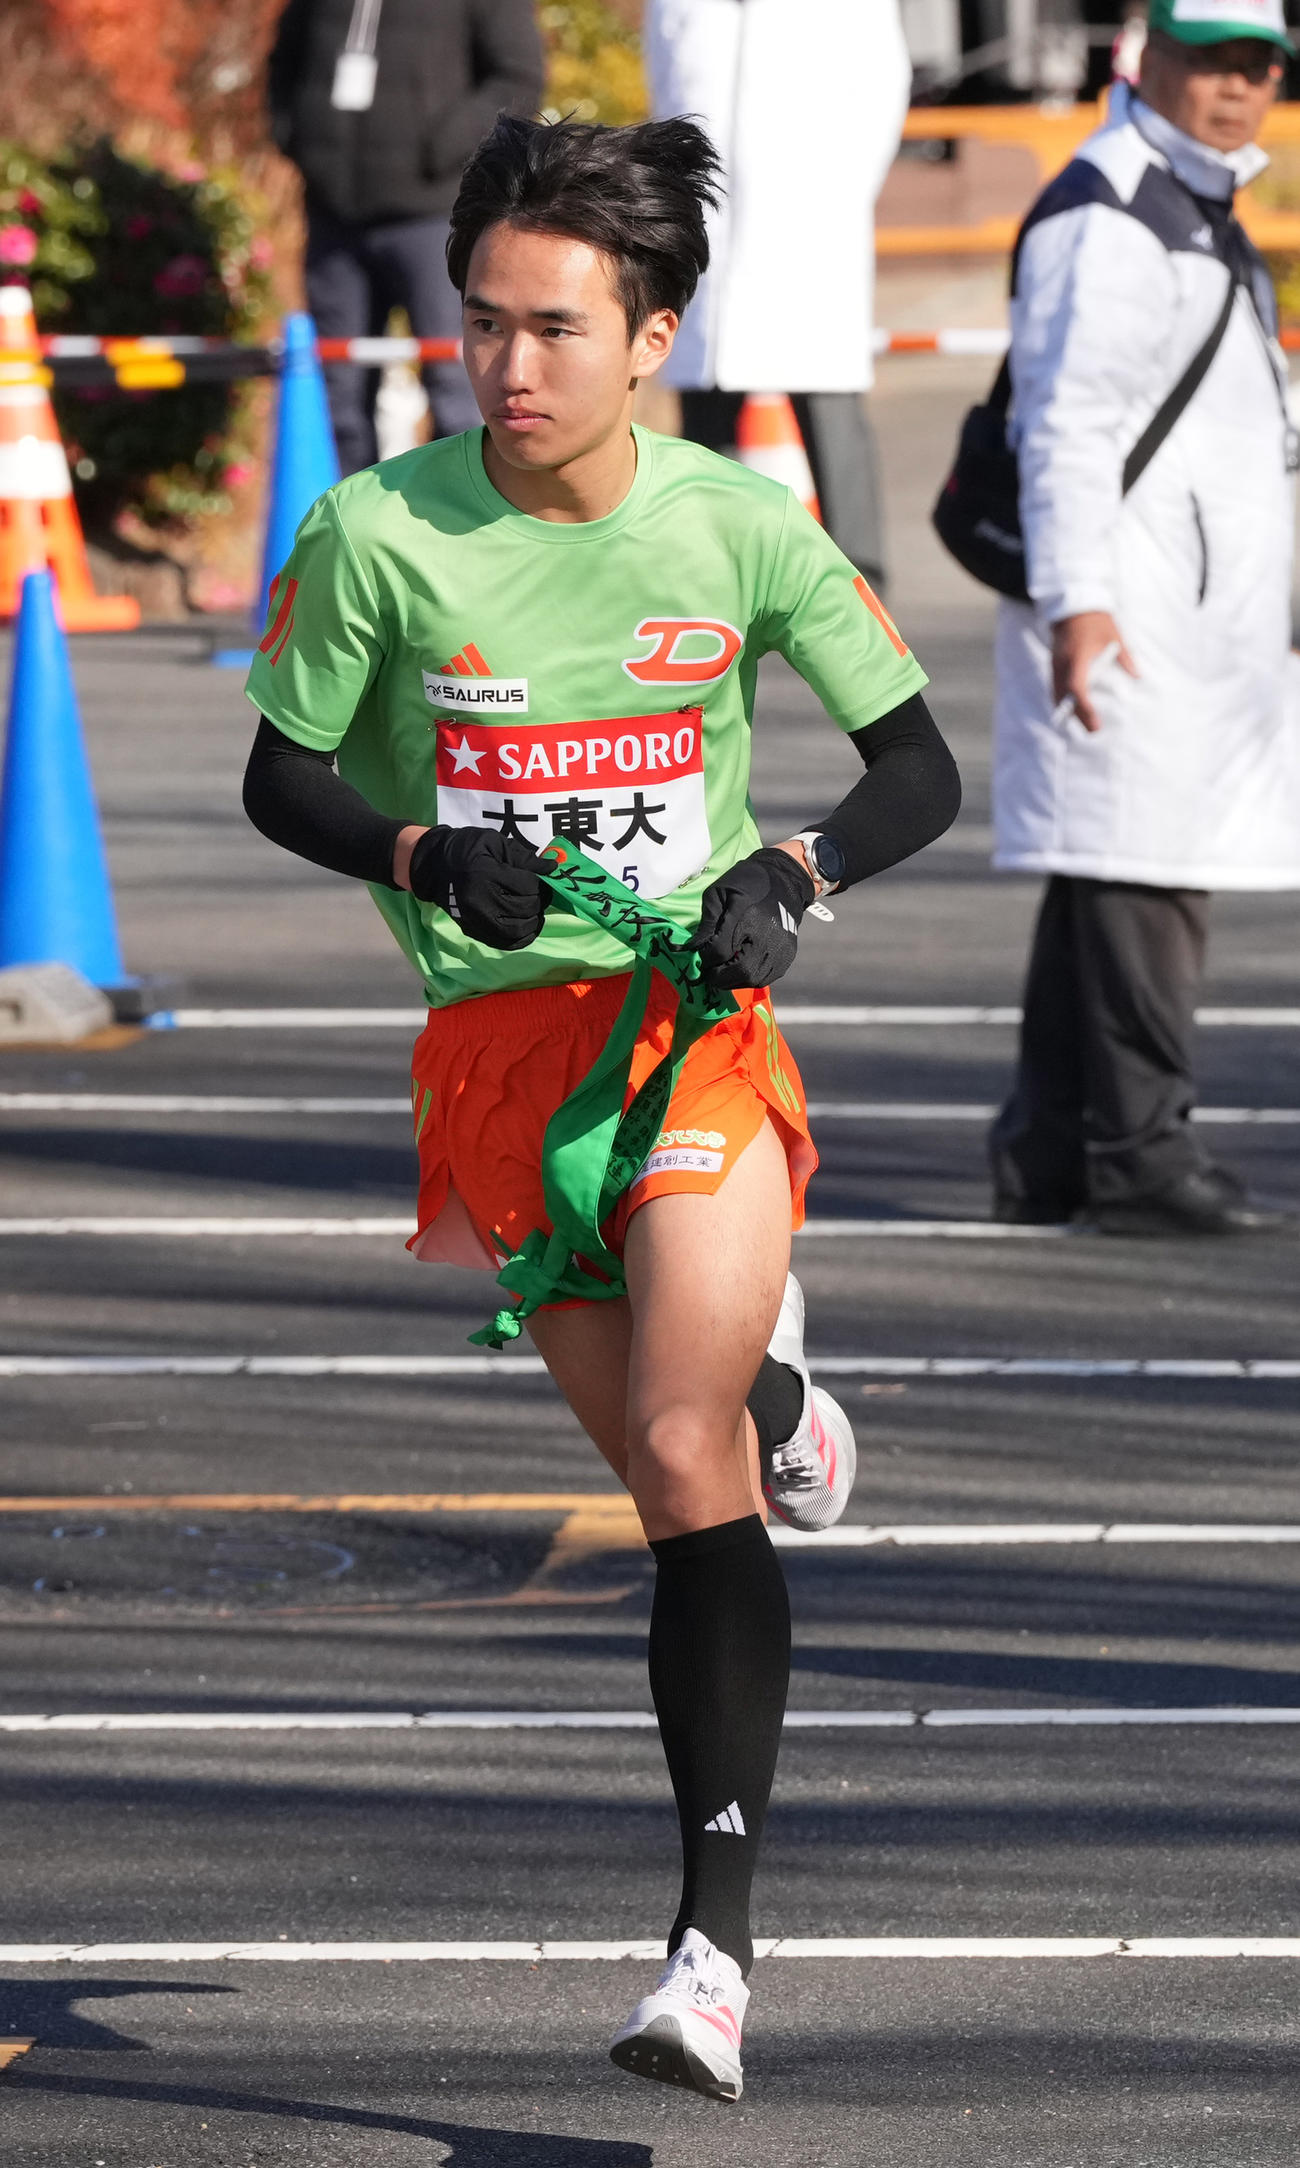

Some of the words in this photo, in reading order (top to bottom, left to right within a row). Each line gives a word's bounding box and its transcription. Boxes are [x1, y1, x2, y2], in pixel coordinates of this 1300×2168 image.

[621, 617, 744, 686] D
[443, 685, 524, 702] SAURUS
[498, 727, 695, 780] SAPPORO
[482, 792, 667, 851] 大東大
